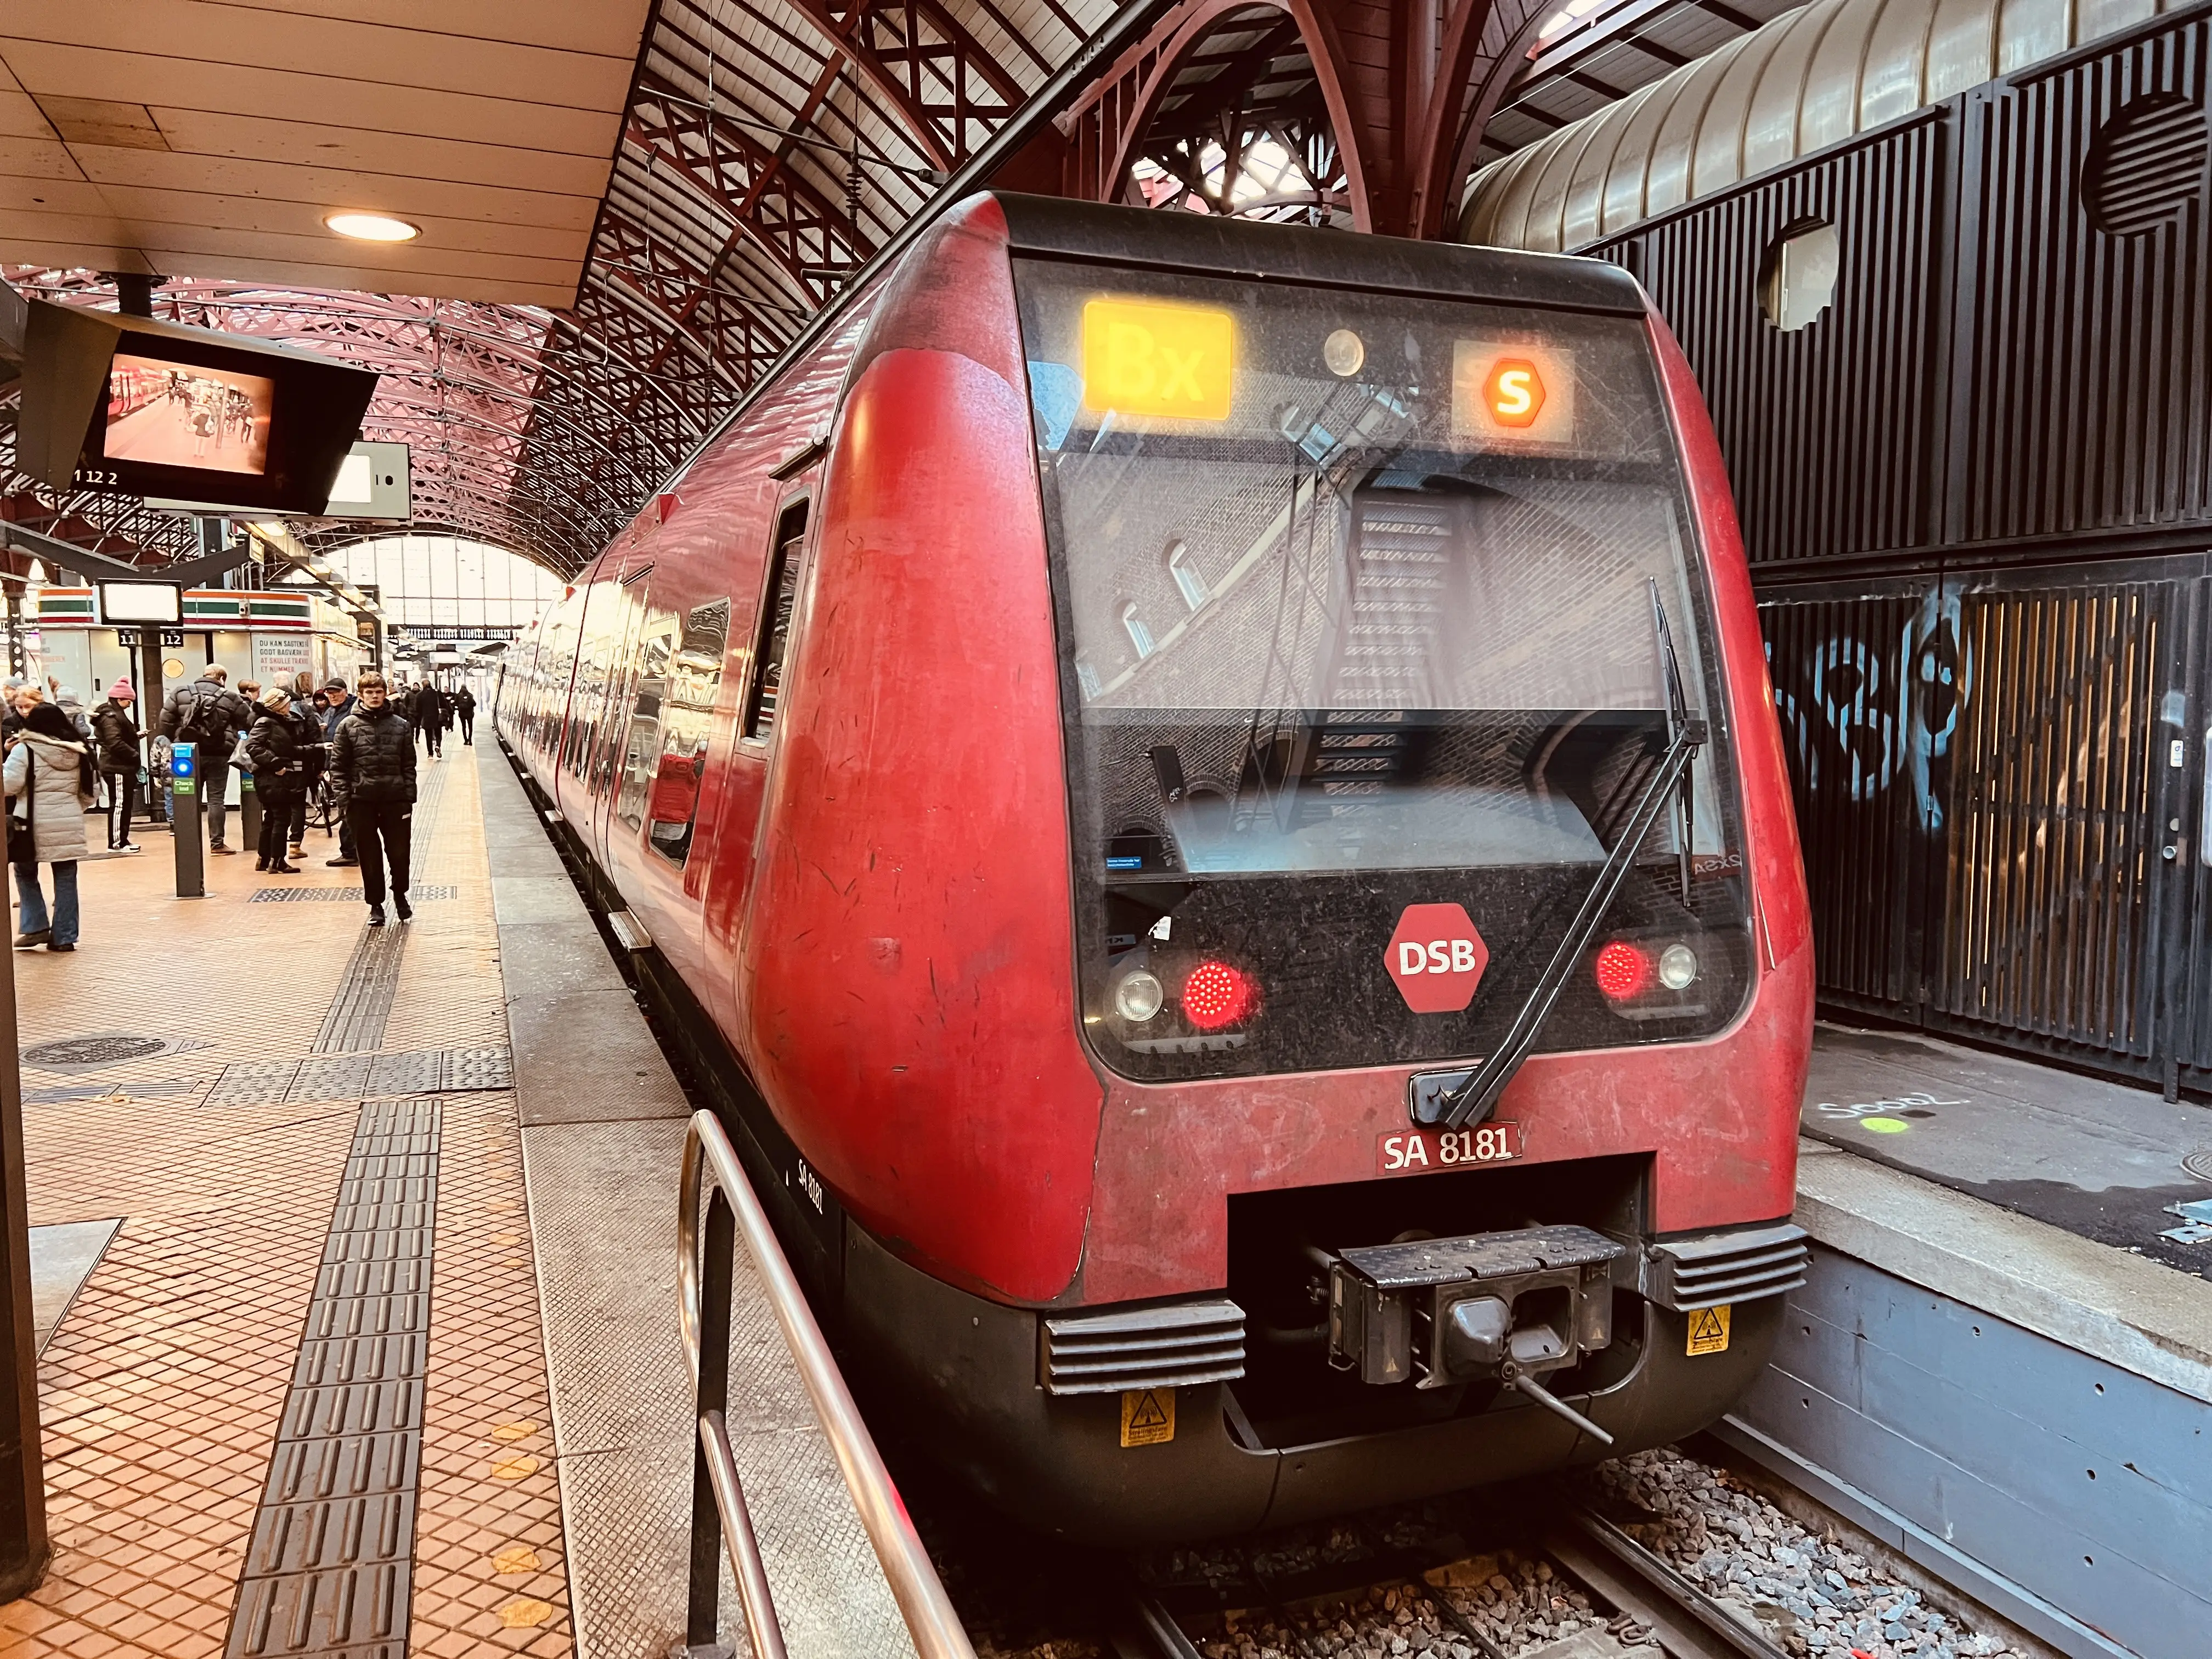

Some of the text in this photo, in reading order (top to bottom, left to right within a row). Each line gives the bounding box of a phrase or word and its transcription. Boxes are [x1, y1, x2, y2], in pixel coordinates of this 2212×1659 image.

[1108, 323, 1205, 402] Bx
[1498, 370, 1531, 414] S
[86, 471, 103, 483] 12
[108, 472, 117, 485] 2
[121, 635, 136, 645] 11
[166, 635, 181, 645] 12
[1400, 939, 1476, 975] DSB
[1384, 1127, 1512, 1170] SA 8181
[798, 1159, 823, 1215] SA 8181
